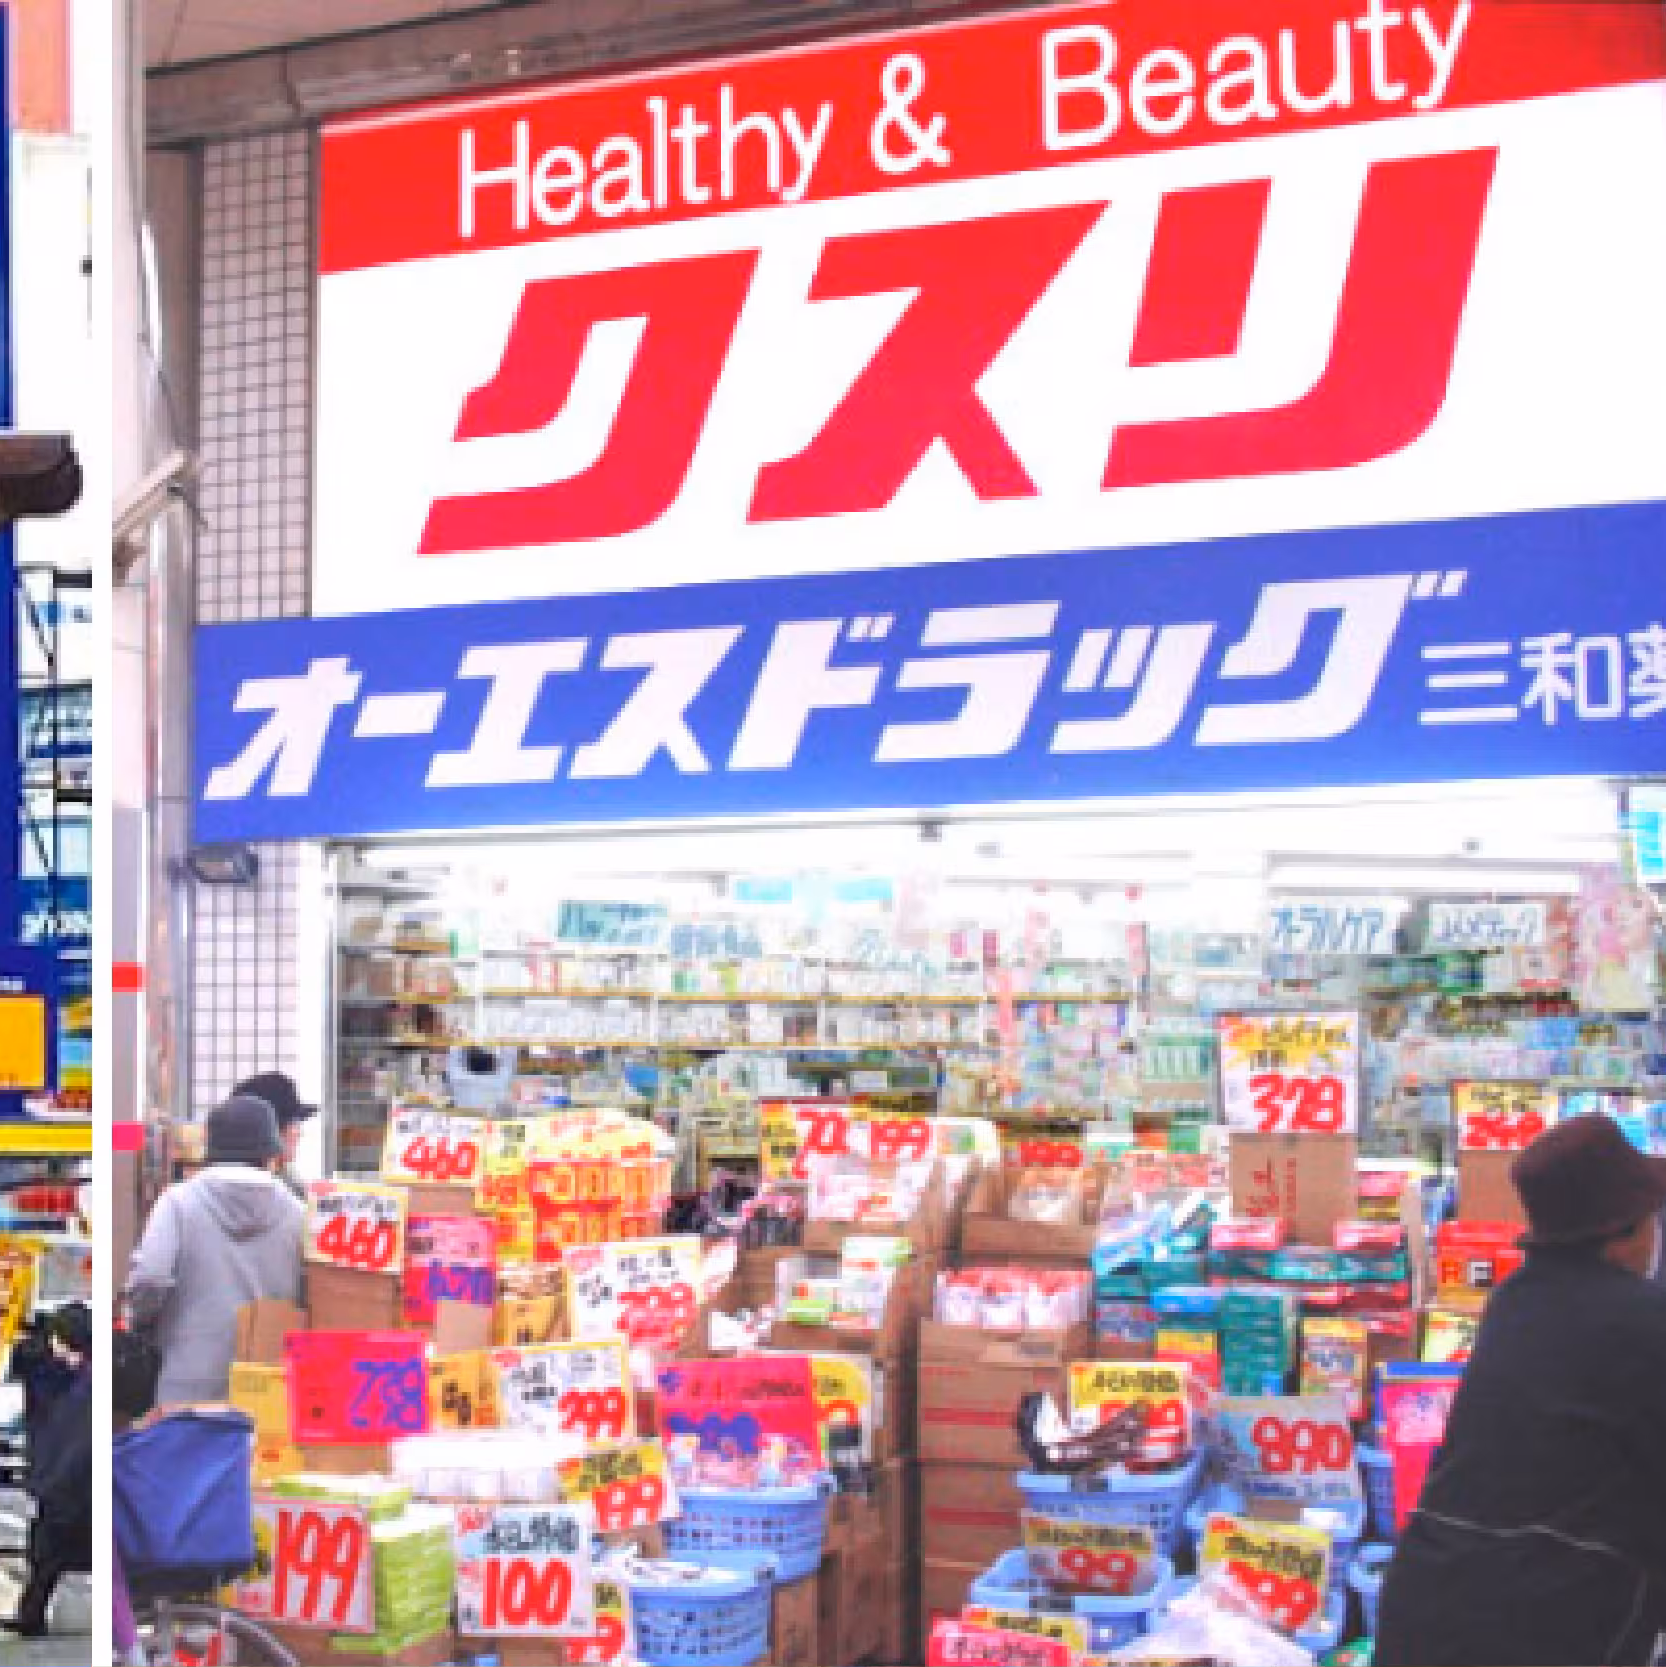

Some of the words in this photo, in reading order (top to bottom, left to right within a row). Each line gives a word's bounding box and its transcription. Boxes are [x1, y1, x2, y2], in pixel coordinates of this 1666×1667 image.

[460, 85, 832, 238] Healthy
[871, 53, 950, 175] &
[1041, 0, 1472, 153] Beauty
[417, 146, 1499, 554] クスリ
[203, 569, 1468, 801] オーエスドラッグ
[274, 1511, 363, 1624] 199
[483, 1559, 573, 1630] 100
